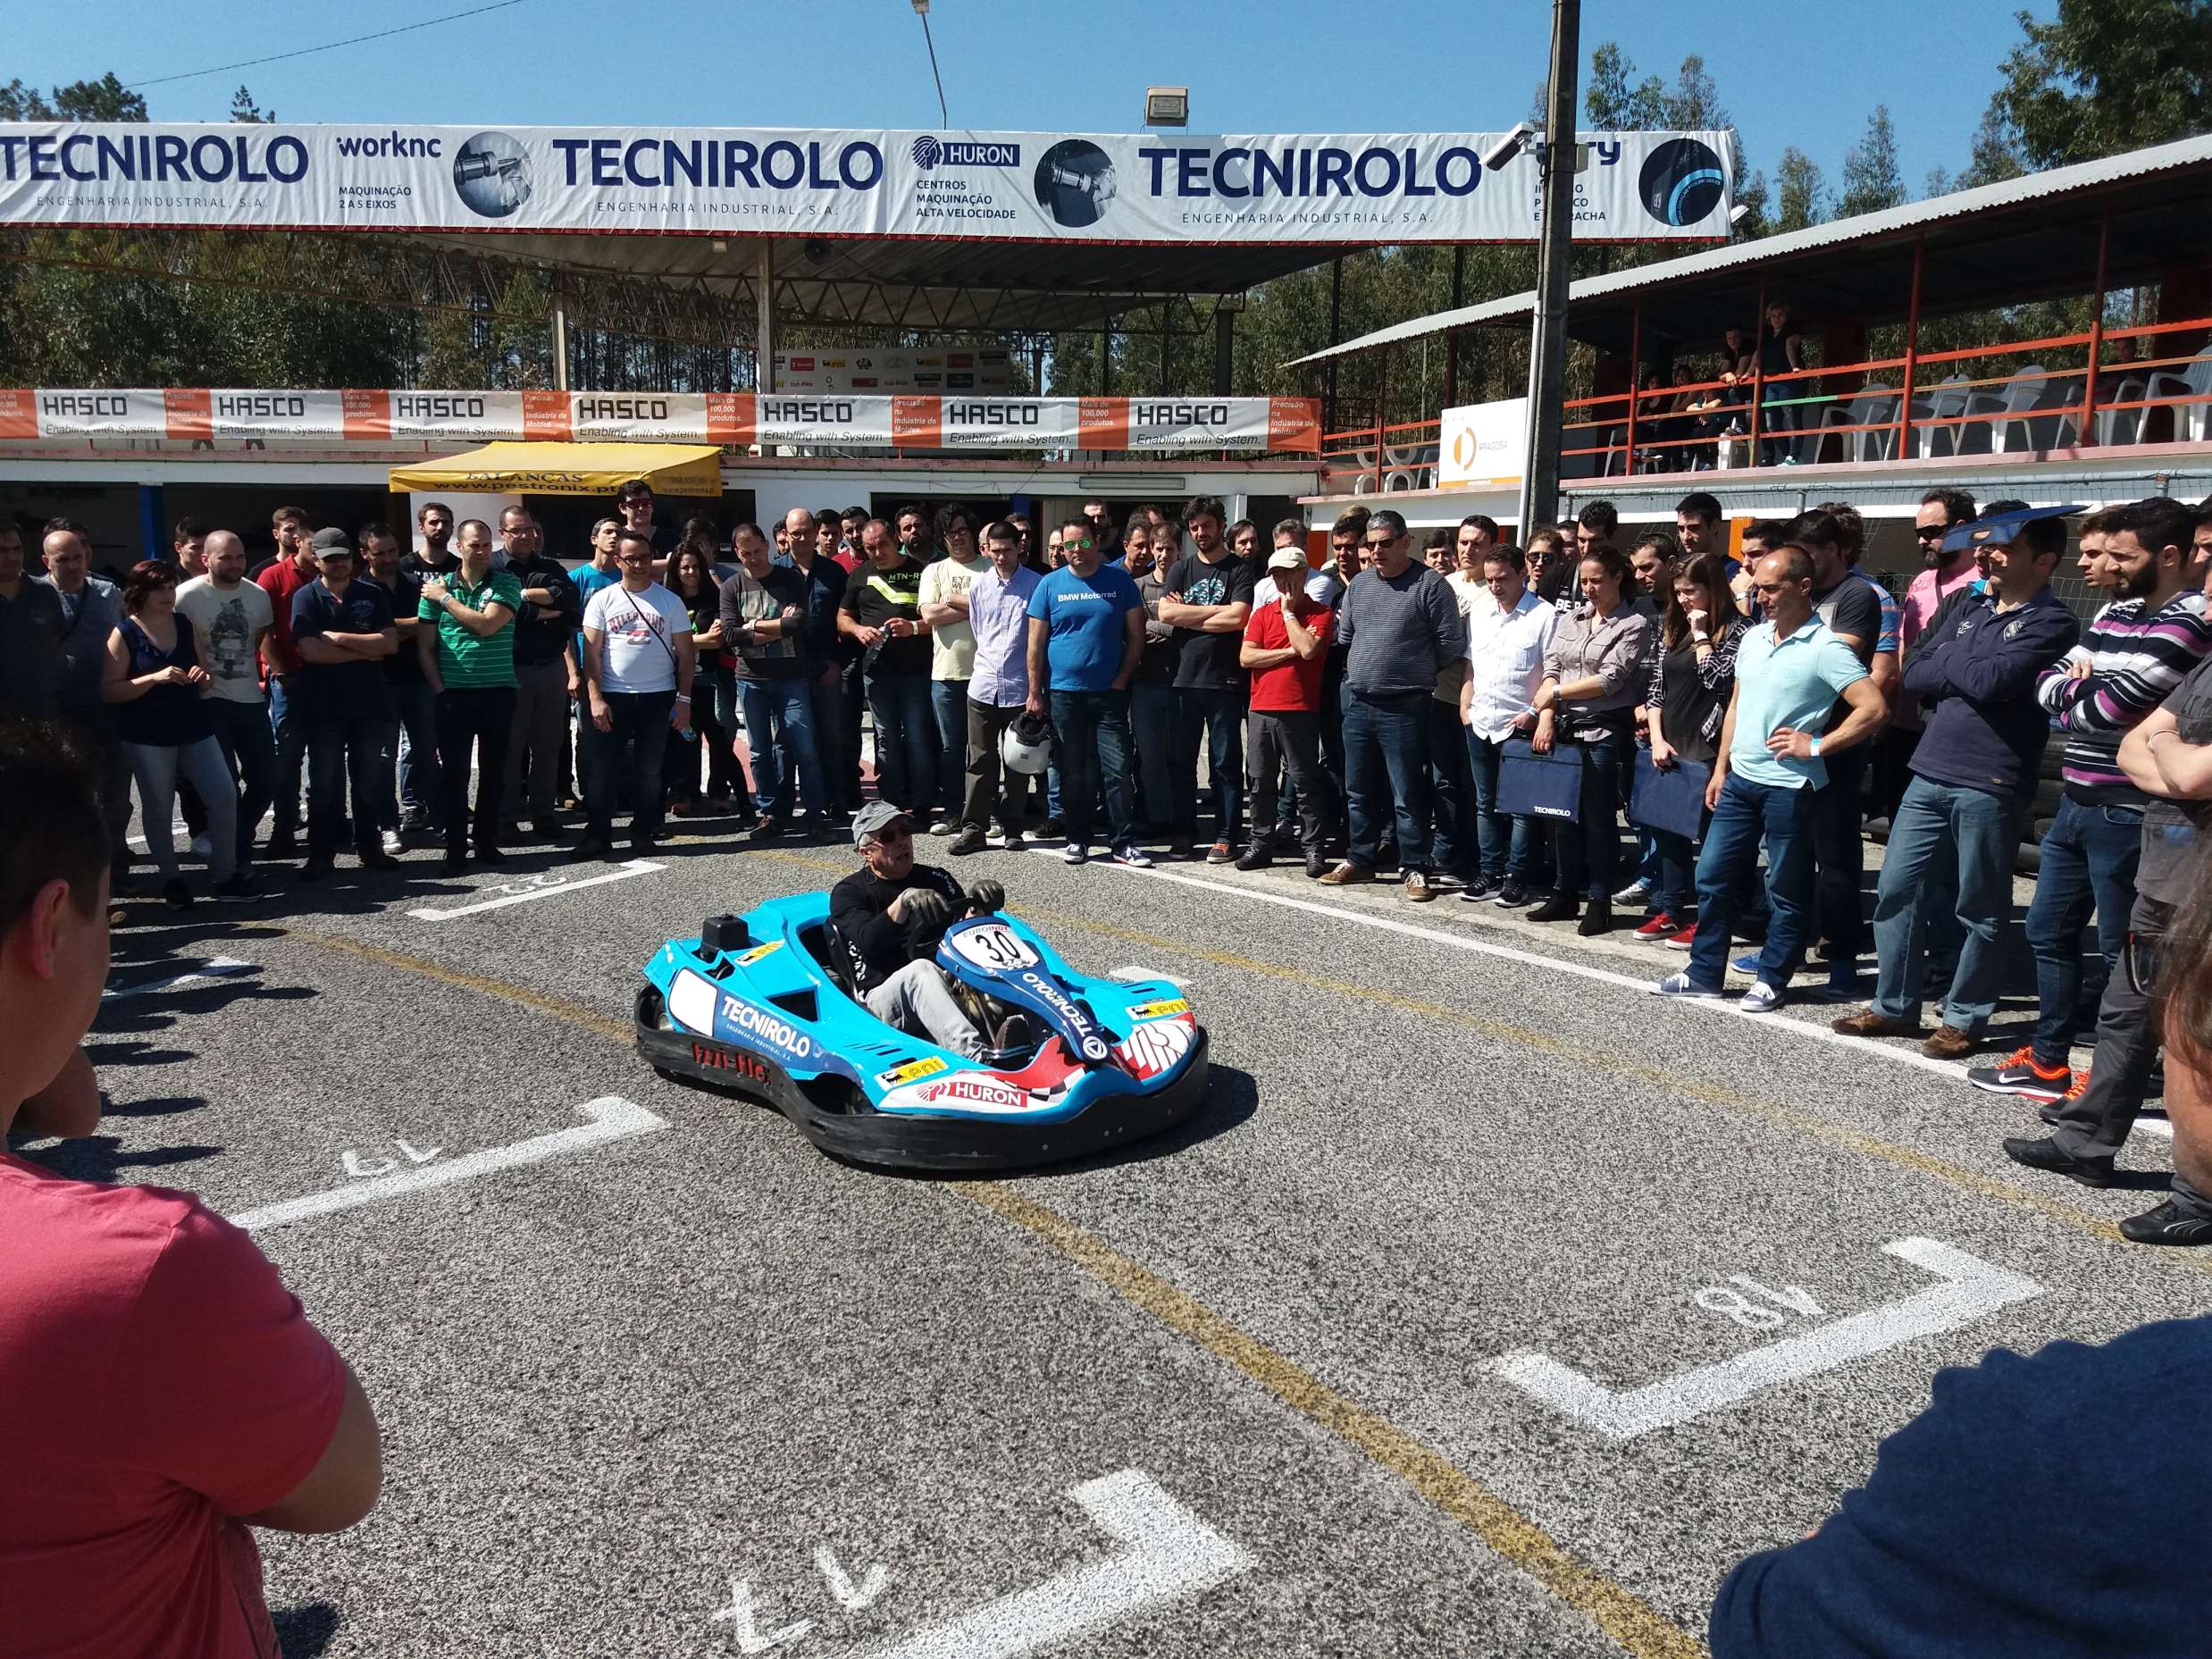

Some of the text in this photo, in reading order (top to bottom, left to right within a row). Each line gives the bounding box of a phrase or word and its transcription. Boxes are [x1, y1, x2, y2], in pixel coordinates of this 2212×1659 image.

[337, 130, 441, 158] worknc
[0, 135, 309, 183] TECNIROLO
[552, 138, 884, 190] TECNIROLO
[949, 146, 1014, 165] HURON
[1139, 147, 1482, 198] TECNIROLO
[338, 184, 412, 198] MAQUINAÇÃO
[916, 180, 967, 190] CENTROS
[37, 195, 269, 210] ENGENHARIA INDUSTRIAL, S.A.
[339, 199, 397, 210] 2 A 5 EIXOS
[916, 191, 993, 205] MAQUINAÇÃO
[598, 201, 839, 217] ENGENHARIA INDUSTRIAL, S.A.
[916, 207, 1017, 220] ALTA VELOCIDADE
[1182, 213, 1433, 225] ENGENHARIA INDUSTRIAL, S.A.
[43, 396, 128, 417] HASCO
[219, 396, 305, 417] HASCO
[398, 398, 484, 417] HASCO
[579, 399, 667, 420] HASCO
[764, 402, 852, 423] HASCO
[950, 404, 1039, 425] HASCO
[1137, 405, 1227, 426] HASCO
[221, 424, 265, 436] Enabling
[269, 423, 291, 435] with
[448, 424, 470, 436] with
[657, 428, 700, 440] System.
[764, 429, 885, 444] Enabling with System.
[950, 432, 1071, 446] Enabling with System.
[1136, 432, 1261, 448] Enabling with System.
[1479, 440, 1508, 451] PRAGOSA
[1057, 591, 1117, 602] BMW Motorrad
[976, 931, 1021, 963] 30
[1022, 972, 1093, 1037] TECNIROLO
[722, 995, 810, 1058] TECNIROLO
[909, 1060, 943, 1077] eni
[955, 1082, 1022, 1106] HURON
